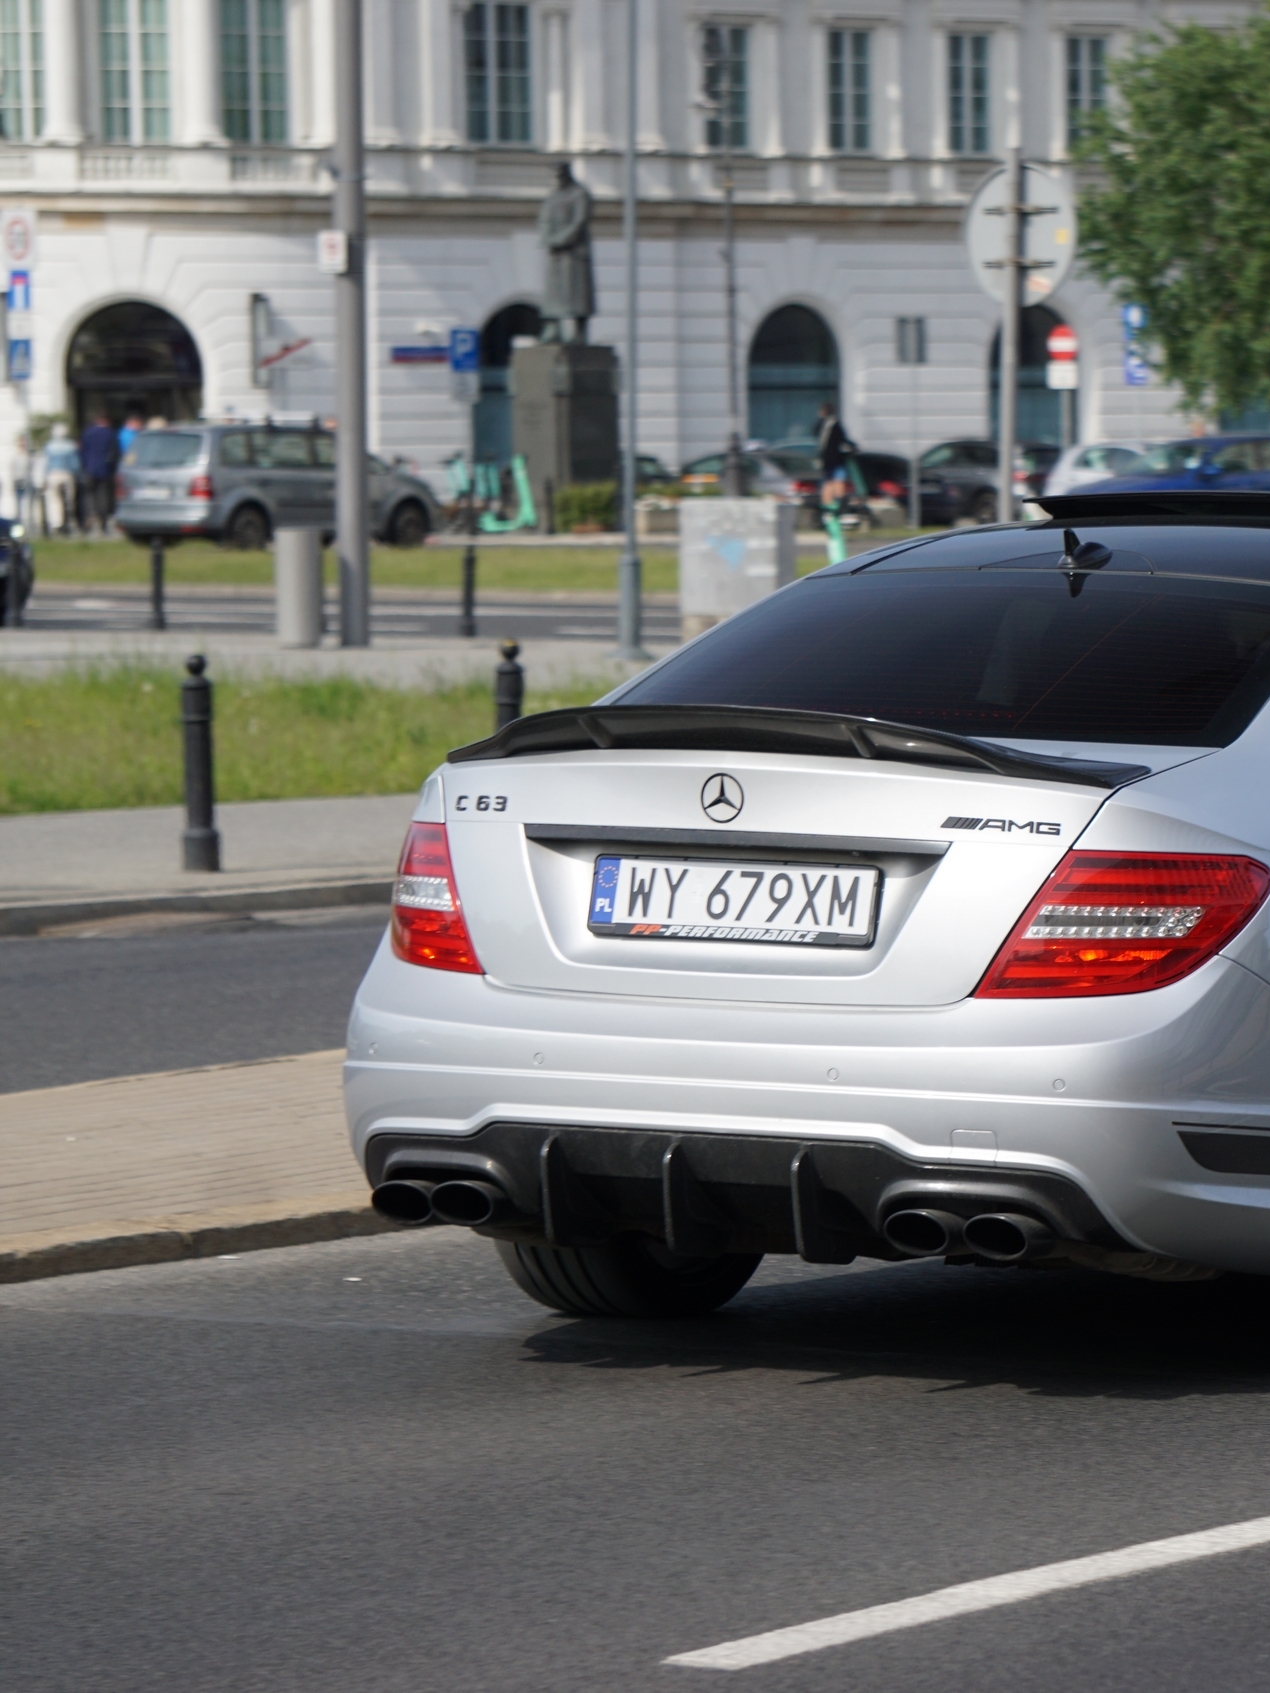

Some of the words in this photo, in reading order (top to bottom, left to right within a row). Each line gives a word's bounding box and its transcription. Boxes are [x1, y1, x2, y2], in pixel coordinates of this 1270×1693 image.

[456, 795, 469, 811] C
[476, 795, 508, 812] 63
[978, 818, 1061, 836] AMG
[595, 897, 612, 913] PL
[628, 866, 689, 919] WY
[706, 869, 860, 928] 679XM
